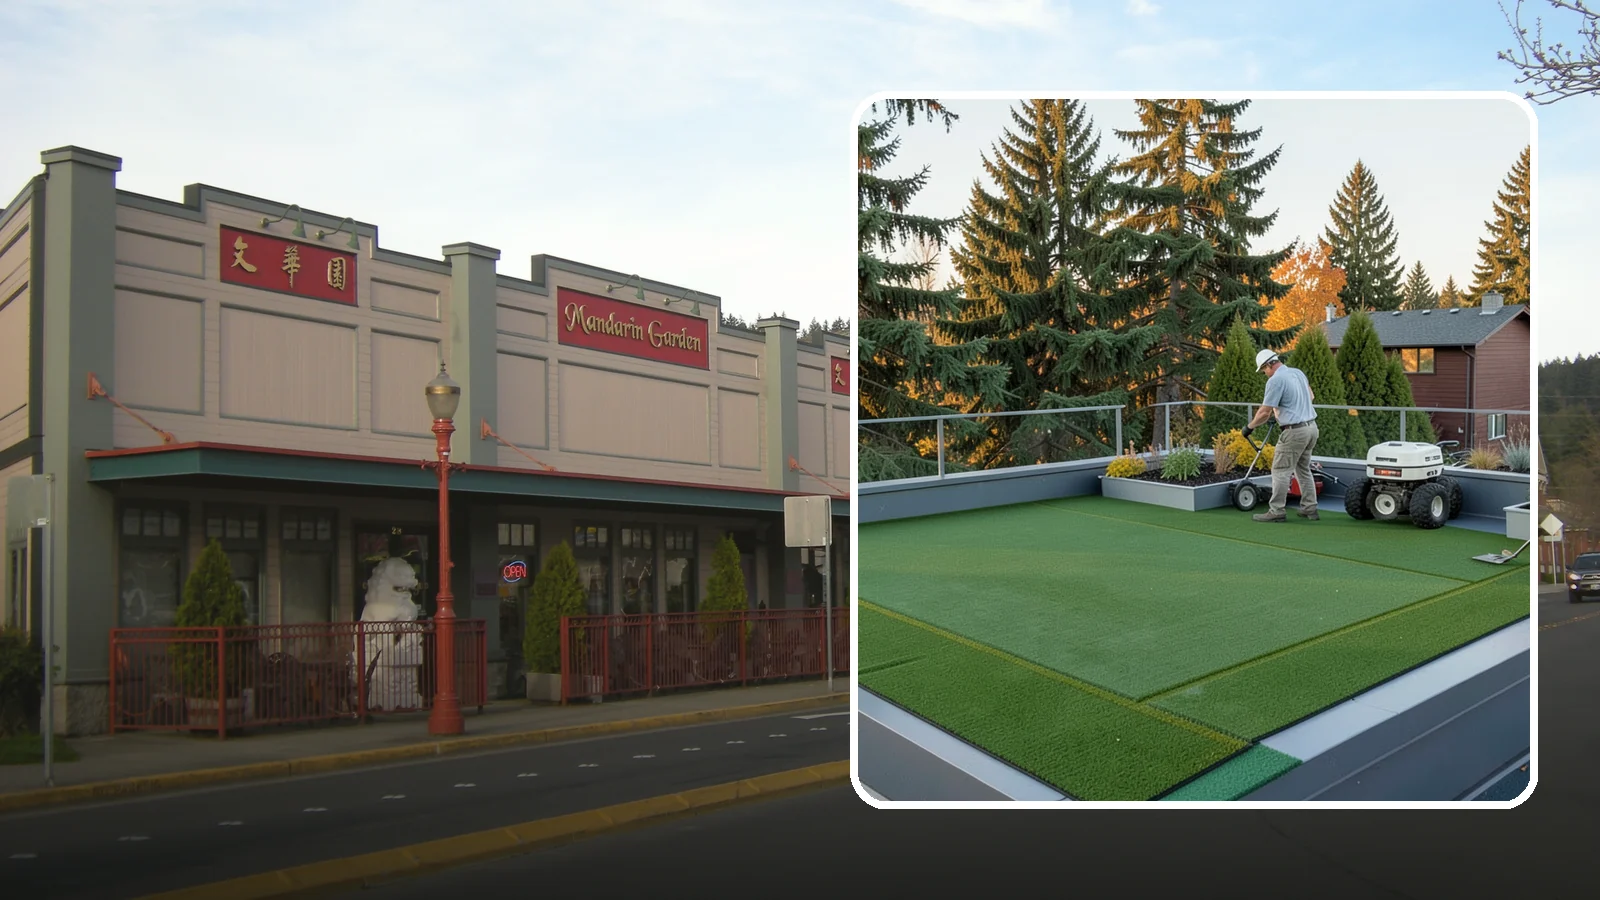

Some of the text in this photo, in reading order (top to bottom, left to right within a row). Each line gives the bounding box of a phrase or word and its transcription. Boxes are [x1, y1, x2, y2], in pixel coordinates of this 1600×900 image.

[564, 302, 702, 352] Mandarin Garden
[503, 565, 527, 578] OPEN
